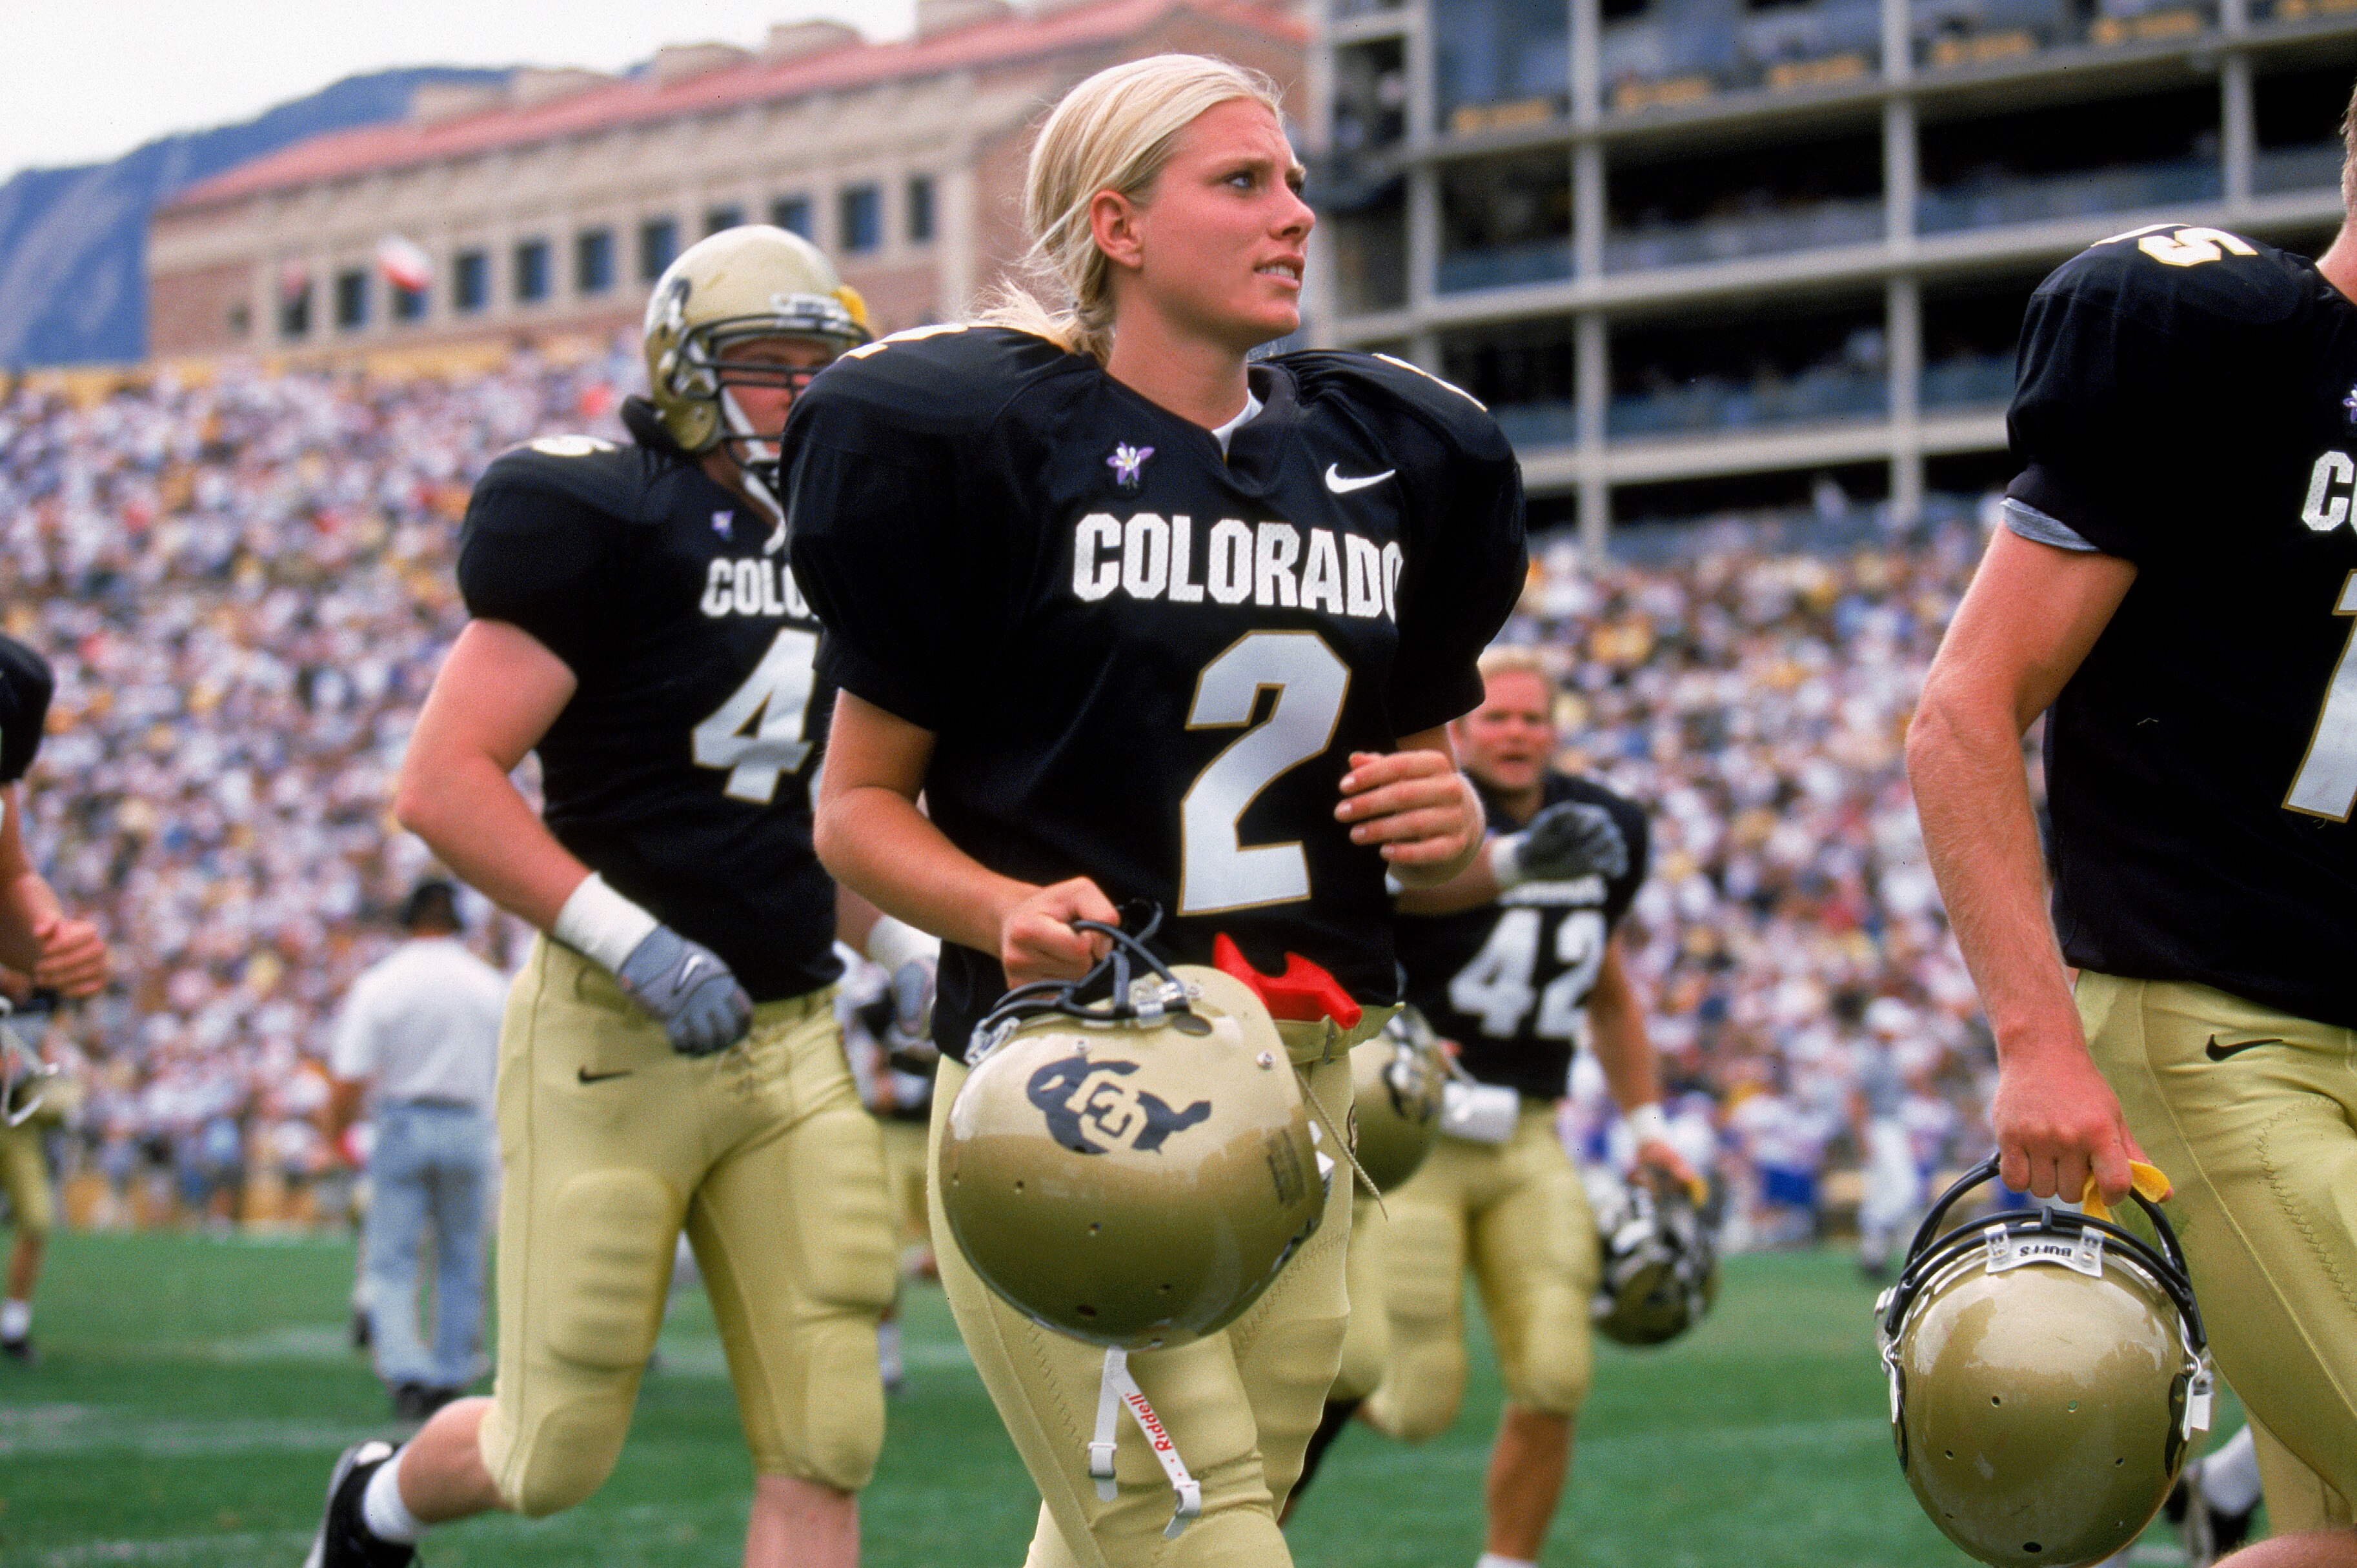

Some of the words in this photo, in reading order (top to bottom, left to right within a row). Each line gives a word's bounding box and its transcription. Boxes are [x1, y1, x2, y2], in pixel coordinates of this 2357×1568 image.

[2301, 450, 2357, 534] C
[700, 558, 820, 622] COLO
[1072, 512, 1405, 624] COLORADO
[691, 627, 823, 813] 4
[1176, 628, 1351, 916] 2
[1448, 907, 1607, 1040] 42
[1127, 1392, 1173, 1452] Riddell
